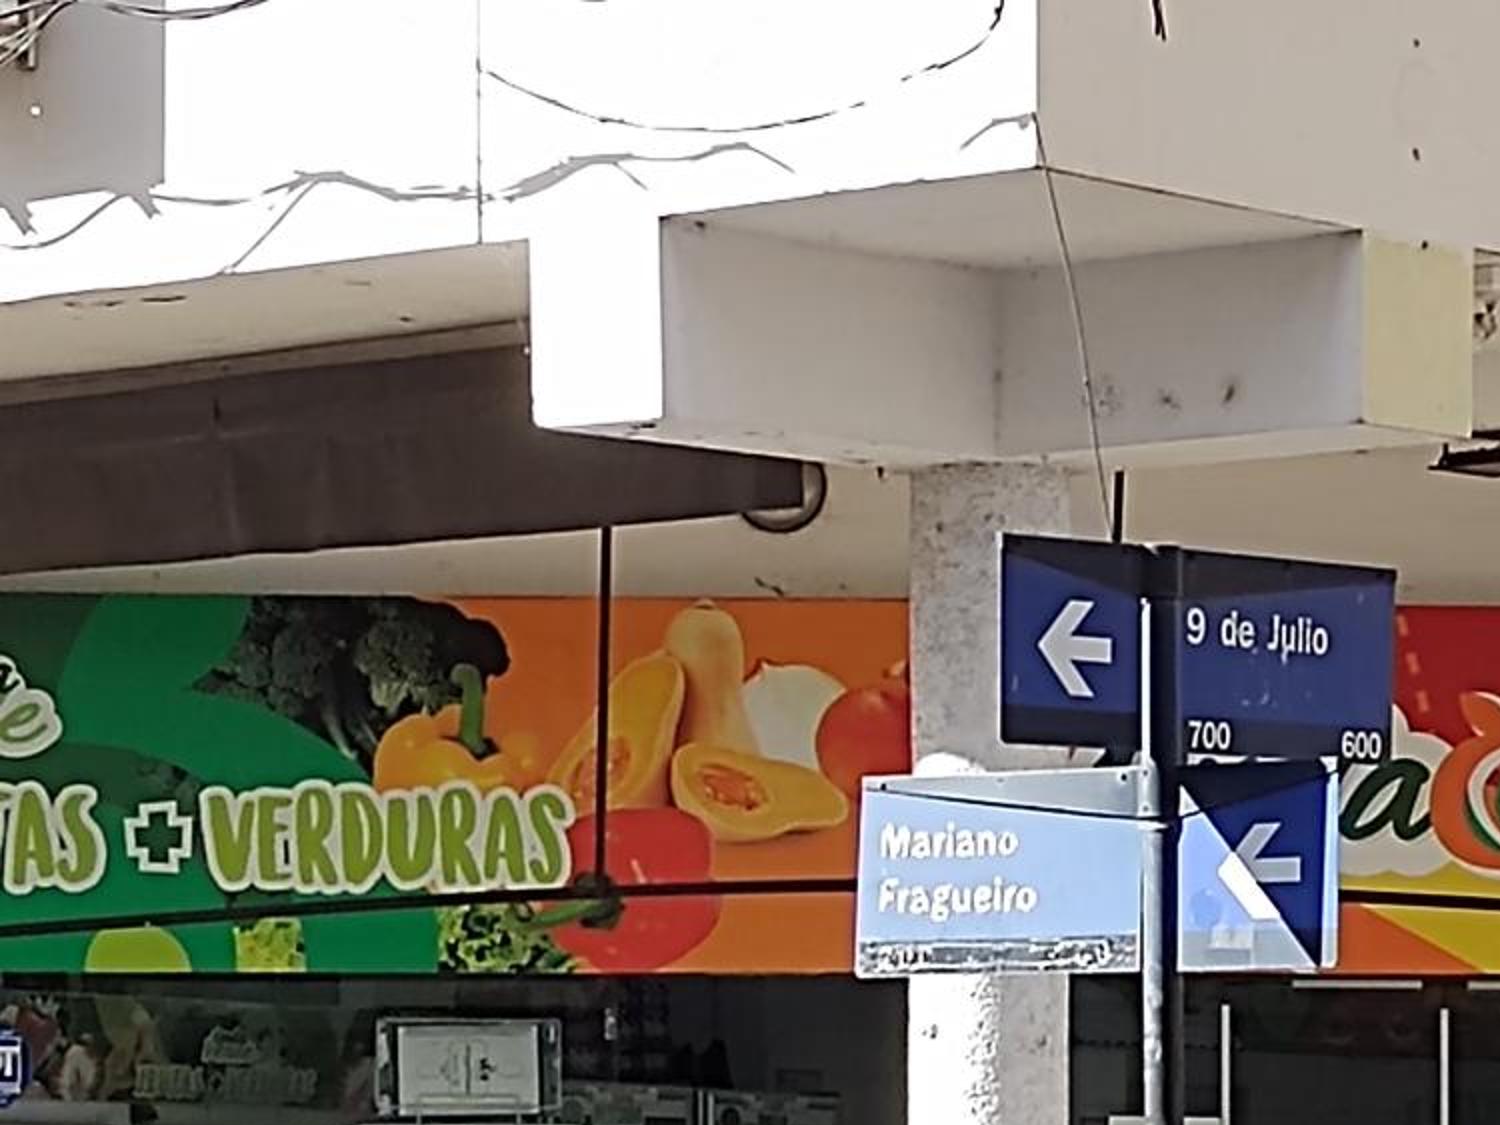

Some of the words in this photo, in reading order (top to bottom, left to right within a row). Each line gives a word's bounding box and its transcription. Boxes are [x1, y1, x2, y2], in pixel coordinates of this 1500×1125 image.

[1187, 607, 1206, 646] 9
[1221, 616, 1256, 648] de
[1267, 617, 1330, 657] Julio
[1188, 720, 1231, 750] 700
[1341, 730, 1383, 761] 600
[203, 785, 572, 889] VERDURAS
[879, 820, 1019, 861] Mariano
[877, 877, 1038, 922] Fragueiro
